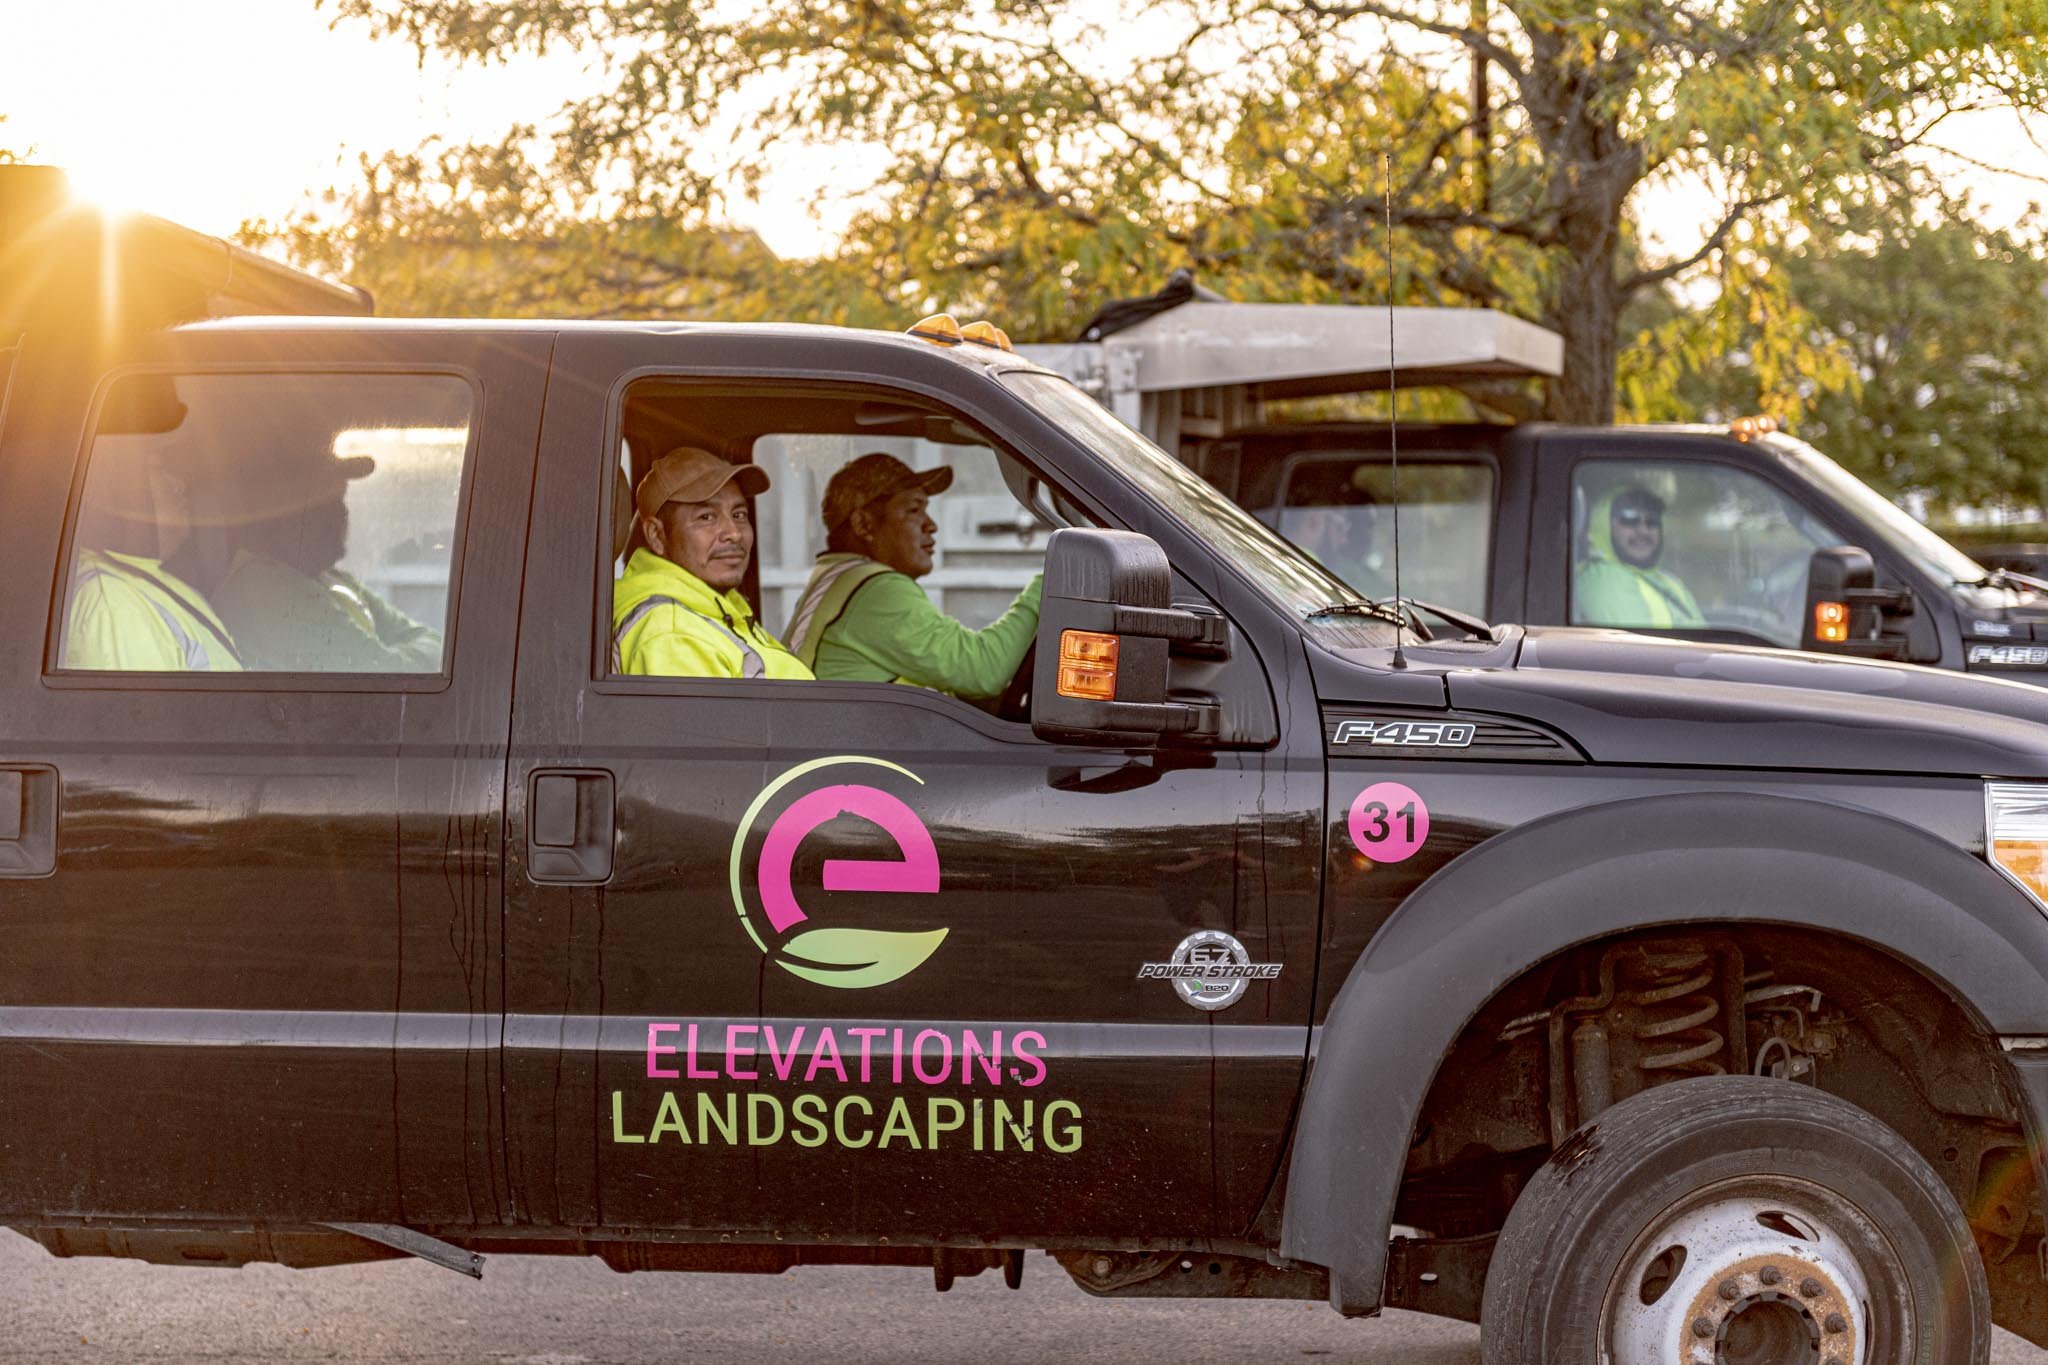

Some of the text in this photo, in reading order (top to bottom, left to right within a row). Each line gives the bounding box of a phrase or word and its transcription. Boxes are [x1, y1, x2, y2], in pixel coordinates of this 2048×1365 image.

[1332, 720, 1476, 747] F-450
[1362, 801, 1415, 843] 31
[1138, 964, 1283, 978] POWER STROKE
[647, 1023, 1048, 1087] ELEVATIONS
[612, 1090, 1083, 1154] LANDSCAPING
